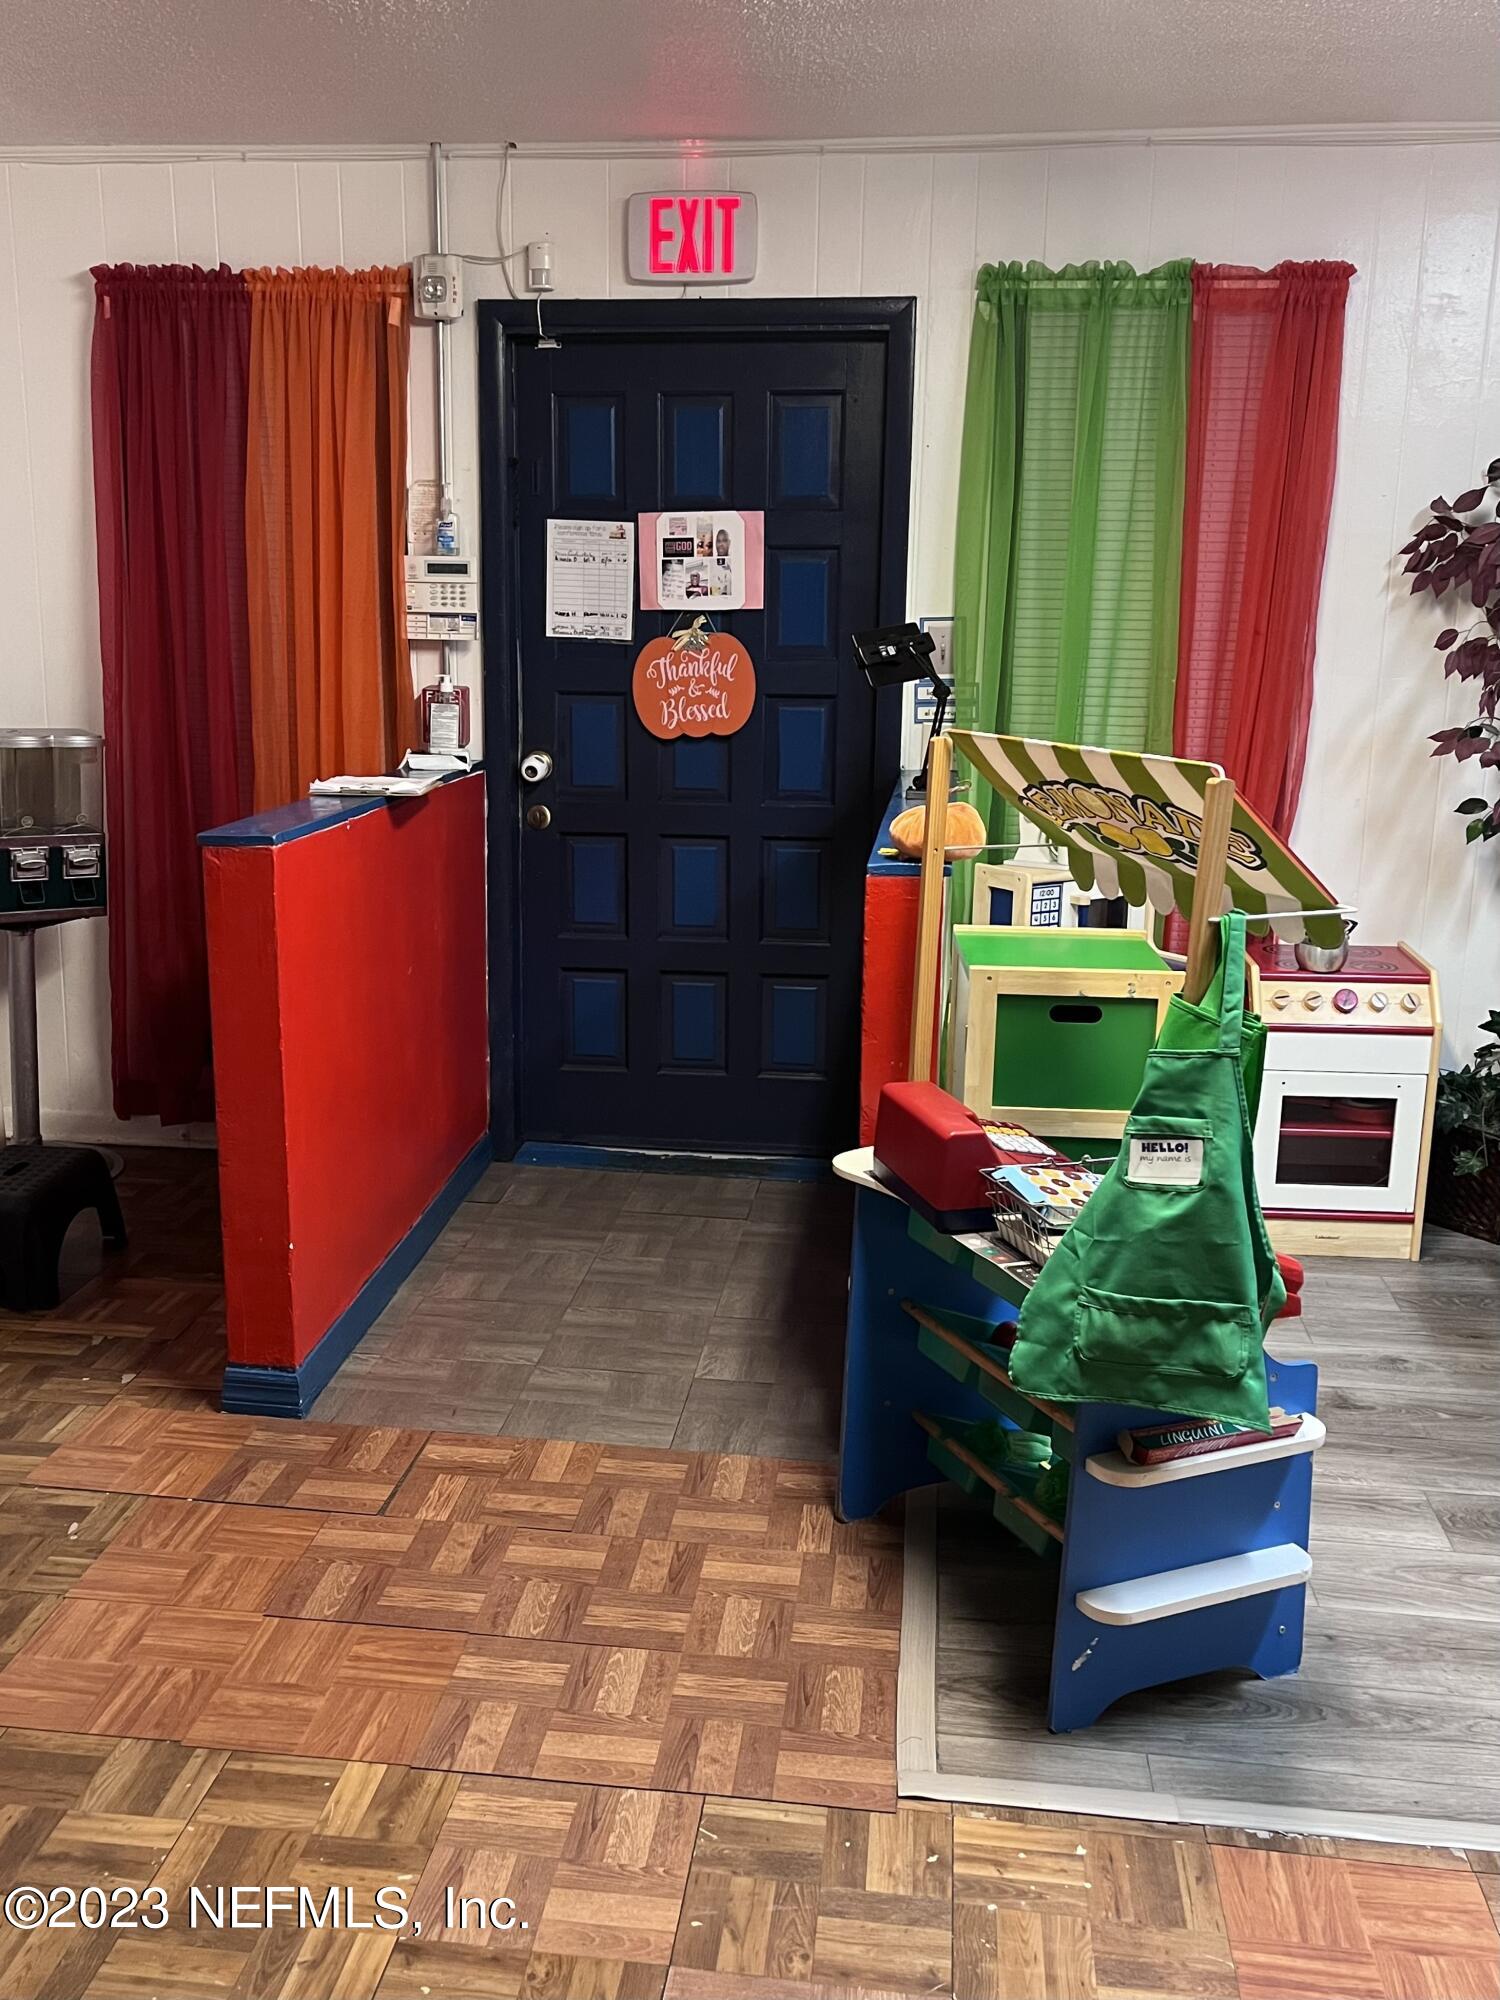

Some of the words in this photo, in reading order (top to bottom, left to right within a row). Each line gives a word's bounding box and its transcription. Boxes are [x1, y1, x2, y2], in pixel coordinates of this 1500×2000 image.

[649, 196, 741, 275] EXIT
[646, 648, 738, 689] Thankful
[688, 678, 705, 697] &
[660, 691, 731, 730] Blessed
[1141, 1142, 1189, 1153] HELLO!
[1139, 1155, 1154, 1164] my
[1156, 1155, 1182, 1163] name
[1184, 1155, 1192, 1163] is
[1160, 1423, 1226, 1446] LINGUINI
